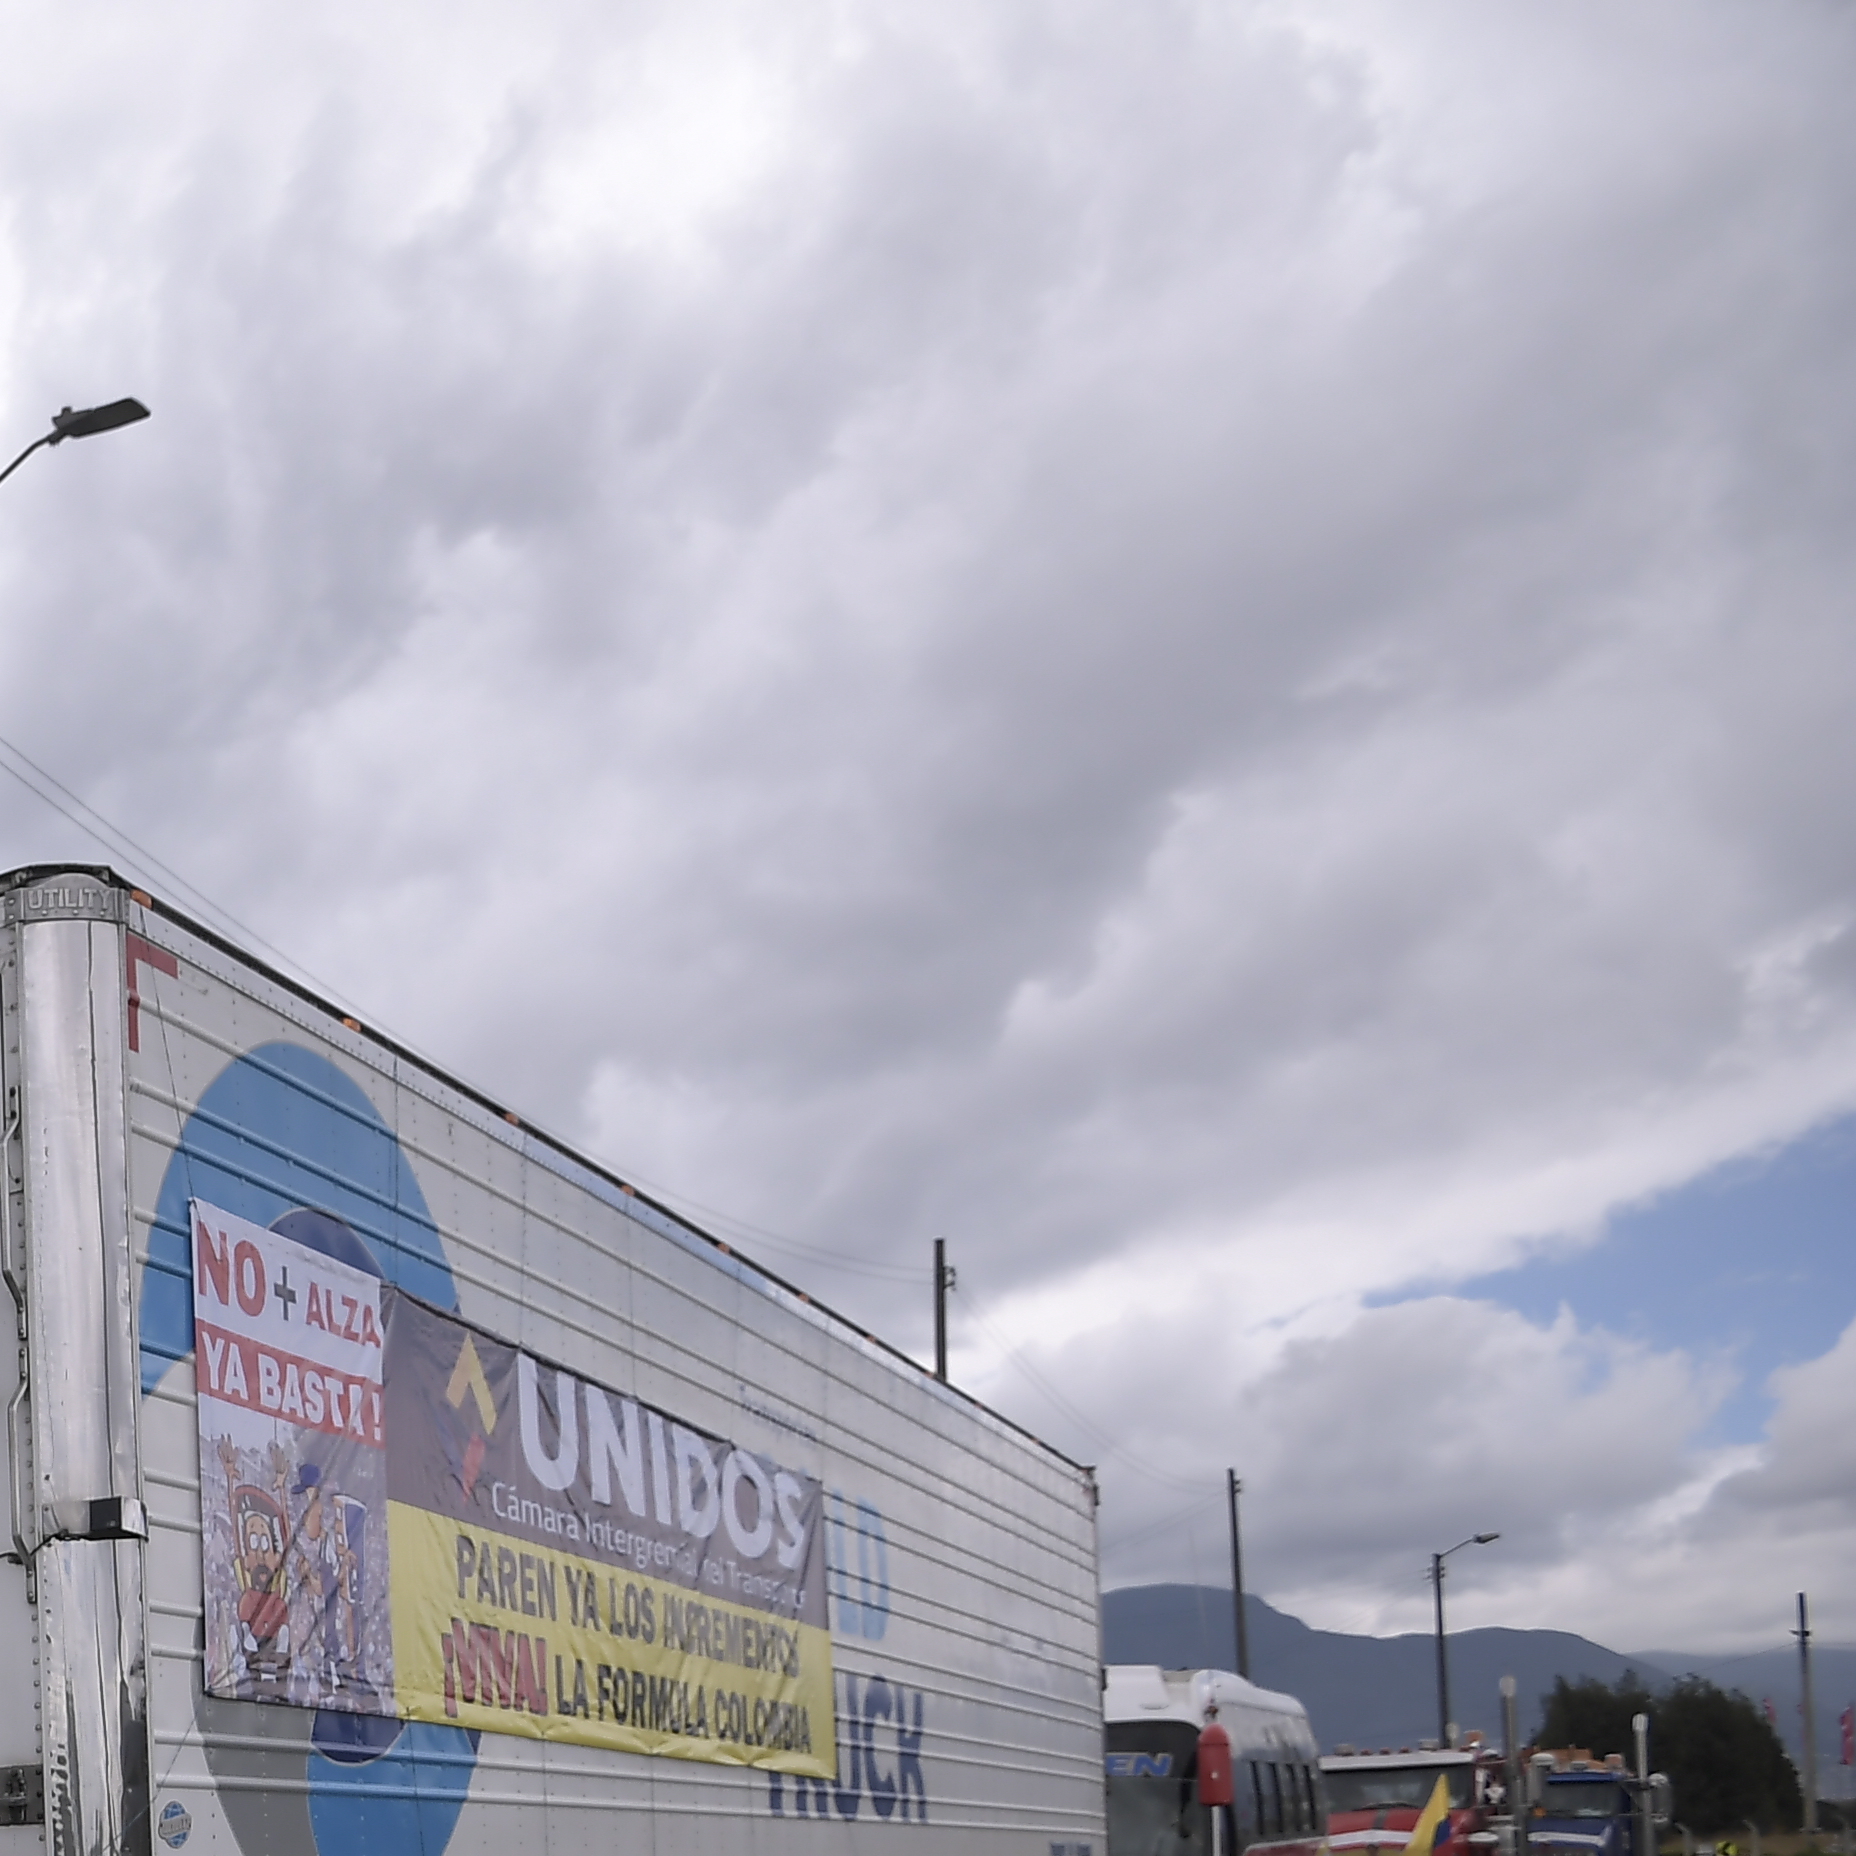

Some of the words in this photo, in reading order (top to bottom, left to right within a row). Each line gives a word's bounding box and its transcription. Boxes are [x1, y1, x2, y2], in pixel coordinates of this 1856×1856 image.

[28, 888, 111, 909] UTILITY
[196, 1220, 267, 1317] NO
[306, 1281, 382, 1349] ALZA
[202, 1331, 249, 1401] YA
[257, 1352, 381, 1442] BASTA!
[492, 1481, 580, 1541] Cámara
[517, 1352, 805, 1569] UNIDOS
[456, 1534, 557, 1622] PAREN
[564, 1565, 601, 1632] YA
[609, 1578, 655, 1644] LOS
[555, 1654, 589, 1719] LA
